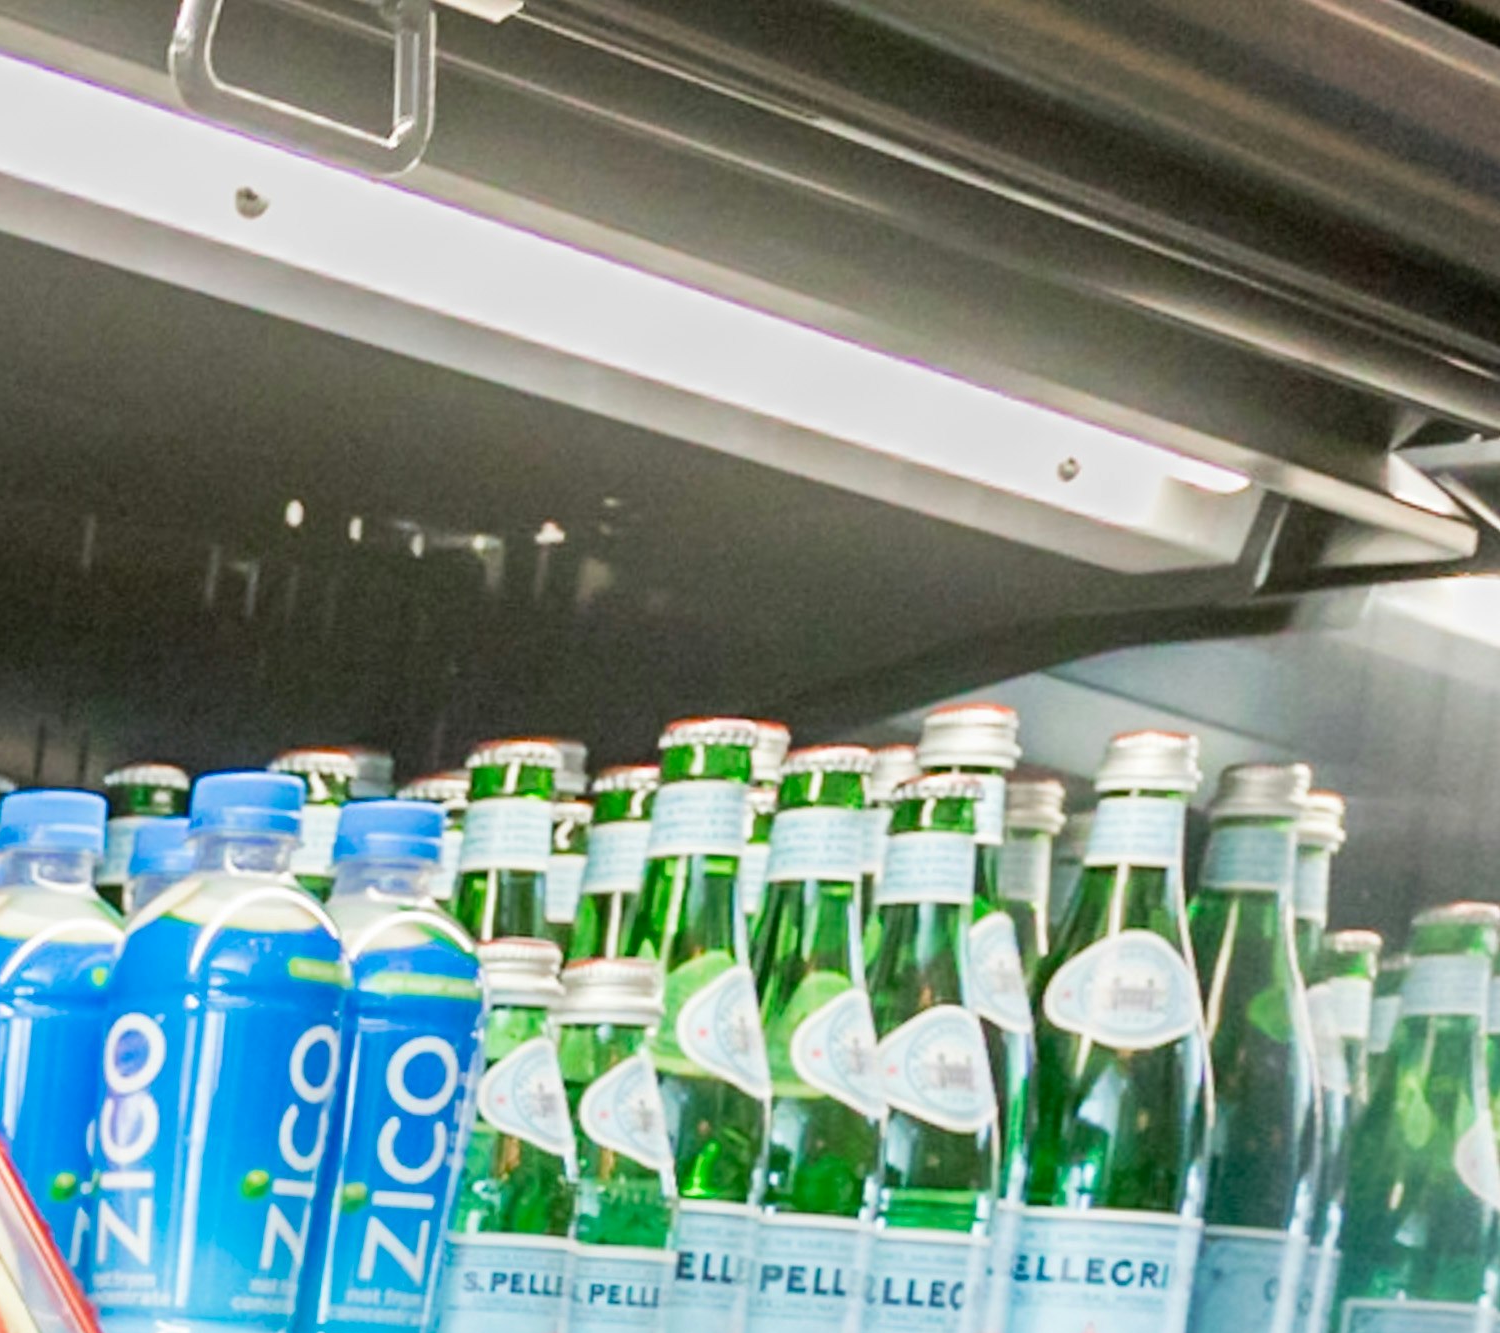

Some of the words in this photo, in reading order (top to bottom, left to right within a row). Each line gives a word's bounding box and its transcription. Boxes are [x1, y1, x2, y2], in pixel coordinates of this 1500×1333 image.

[97, 1013, 167, 1267] ZICO
[260, 1024, 341, 1272] ZICO
[358, 1035, 460, 1285] ZICO
